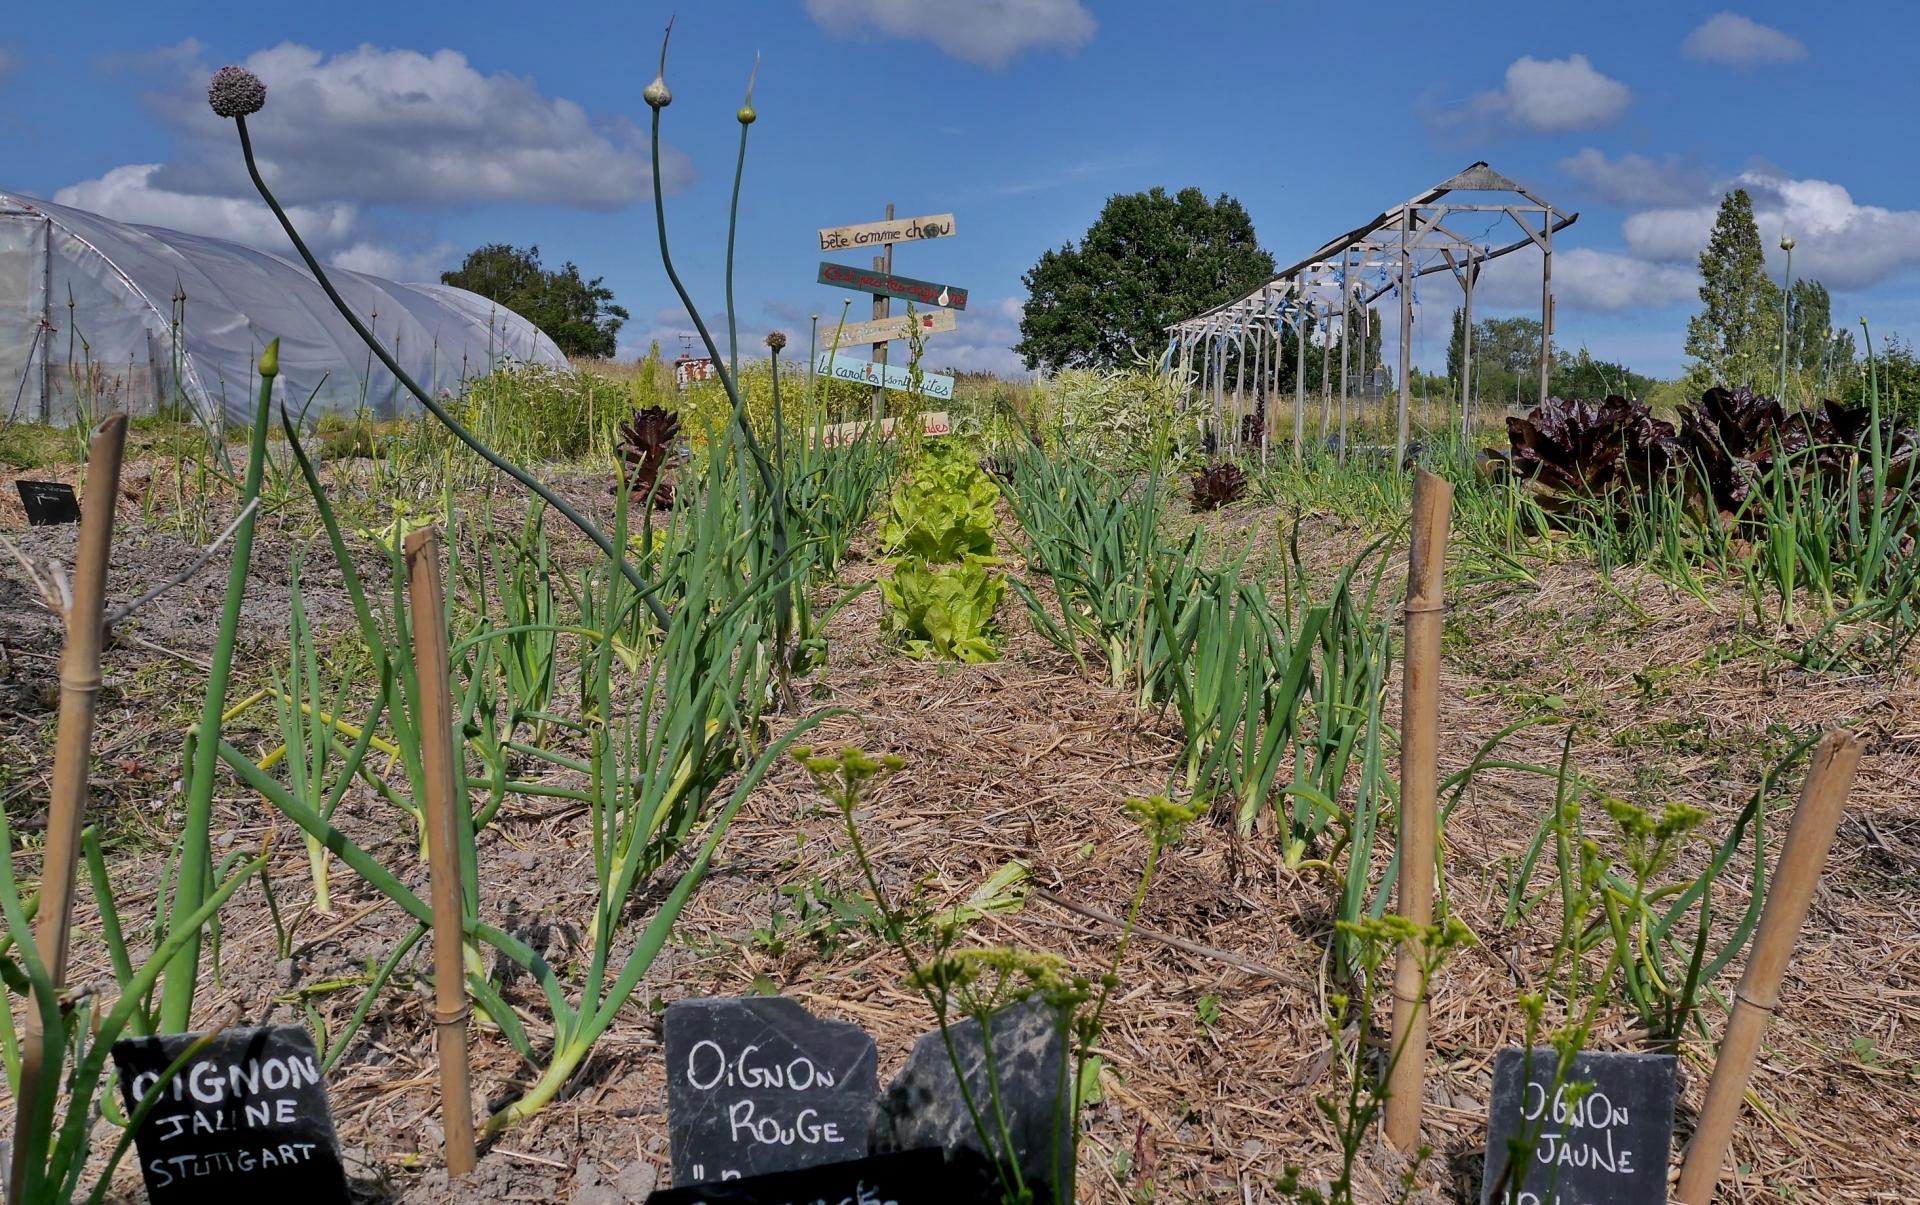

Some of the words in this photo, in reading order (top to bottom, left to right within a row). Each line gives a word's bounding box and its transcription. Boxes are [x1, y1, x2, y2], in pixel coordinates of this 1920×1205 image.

[819, 231, 850, 250] bête
[854, 229, 901, 244] comme
[132, 1055, 320, 1105] OIGNON
[1536, 1128, 1635, 1174] JAUNE
